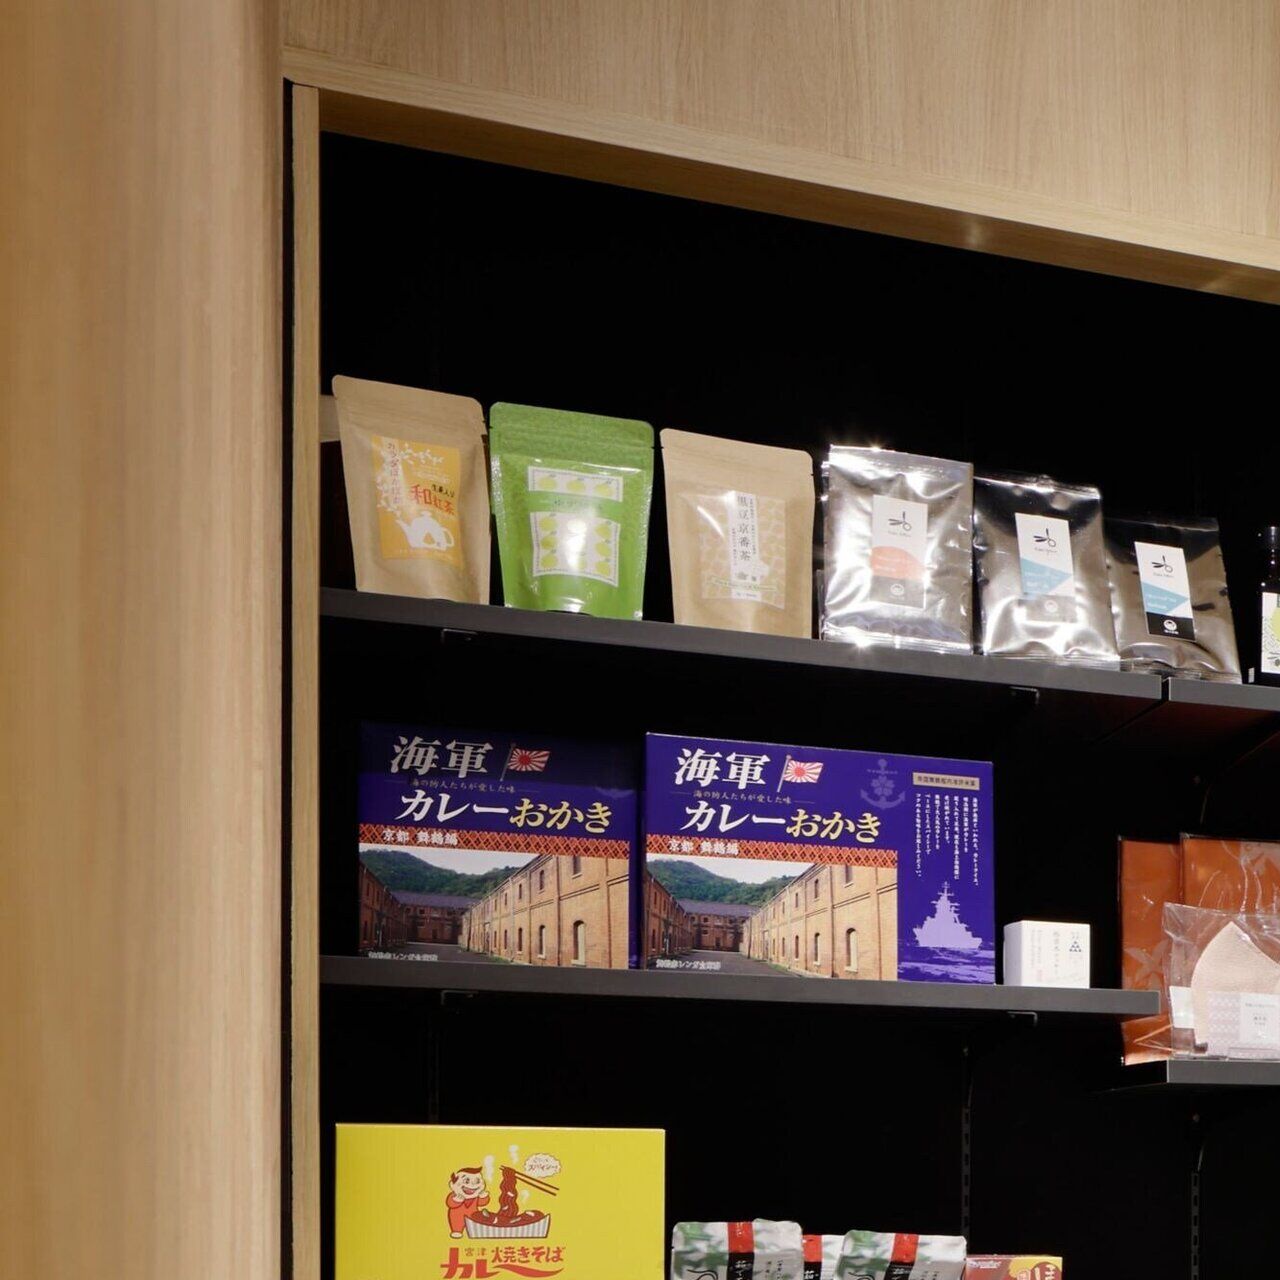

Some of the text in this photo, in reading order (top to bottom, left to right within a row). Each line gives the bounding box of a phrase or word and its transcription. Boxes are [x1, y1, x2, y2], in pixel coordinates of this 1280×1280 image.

[389, 735, 494, 778] 海軍
[674, 747, 771, 790] 海軍
[394, 789, 614, 834] カレーおかき
[680, 800, 881, 843] カレーおかき
[439, 1247, 565, 1280] カレー
[491, 1246, 566, 1264] 焼きそば
